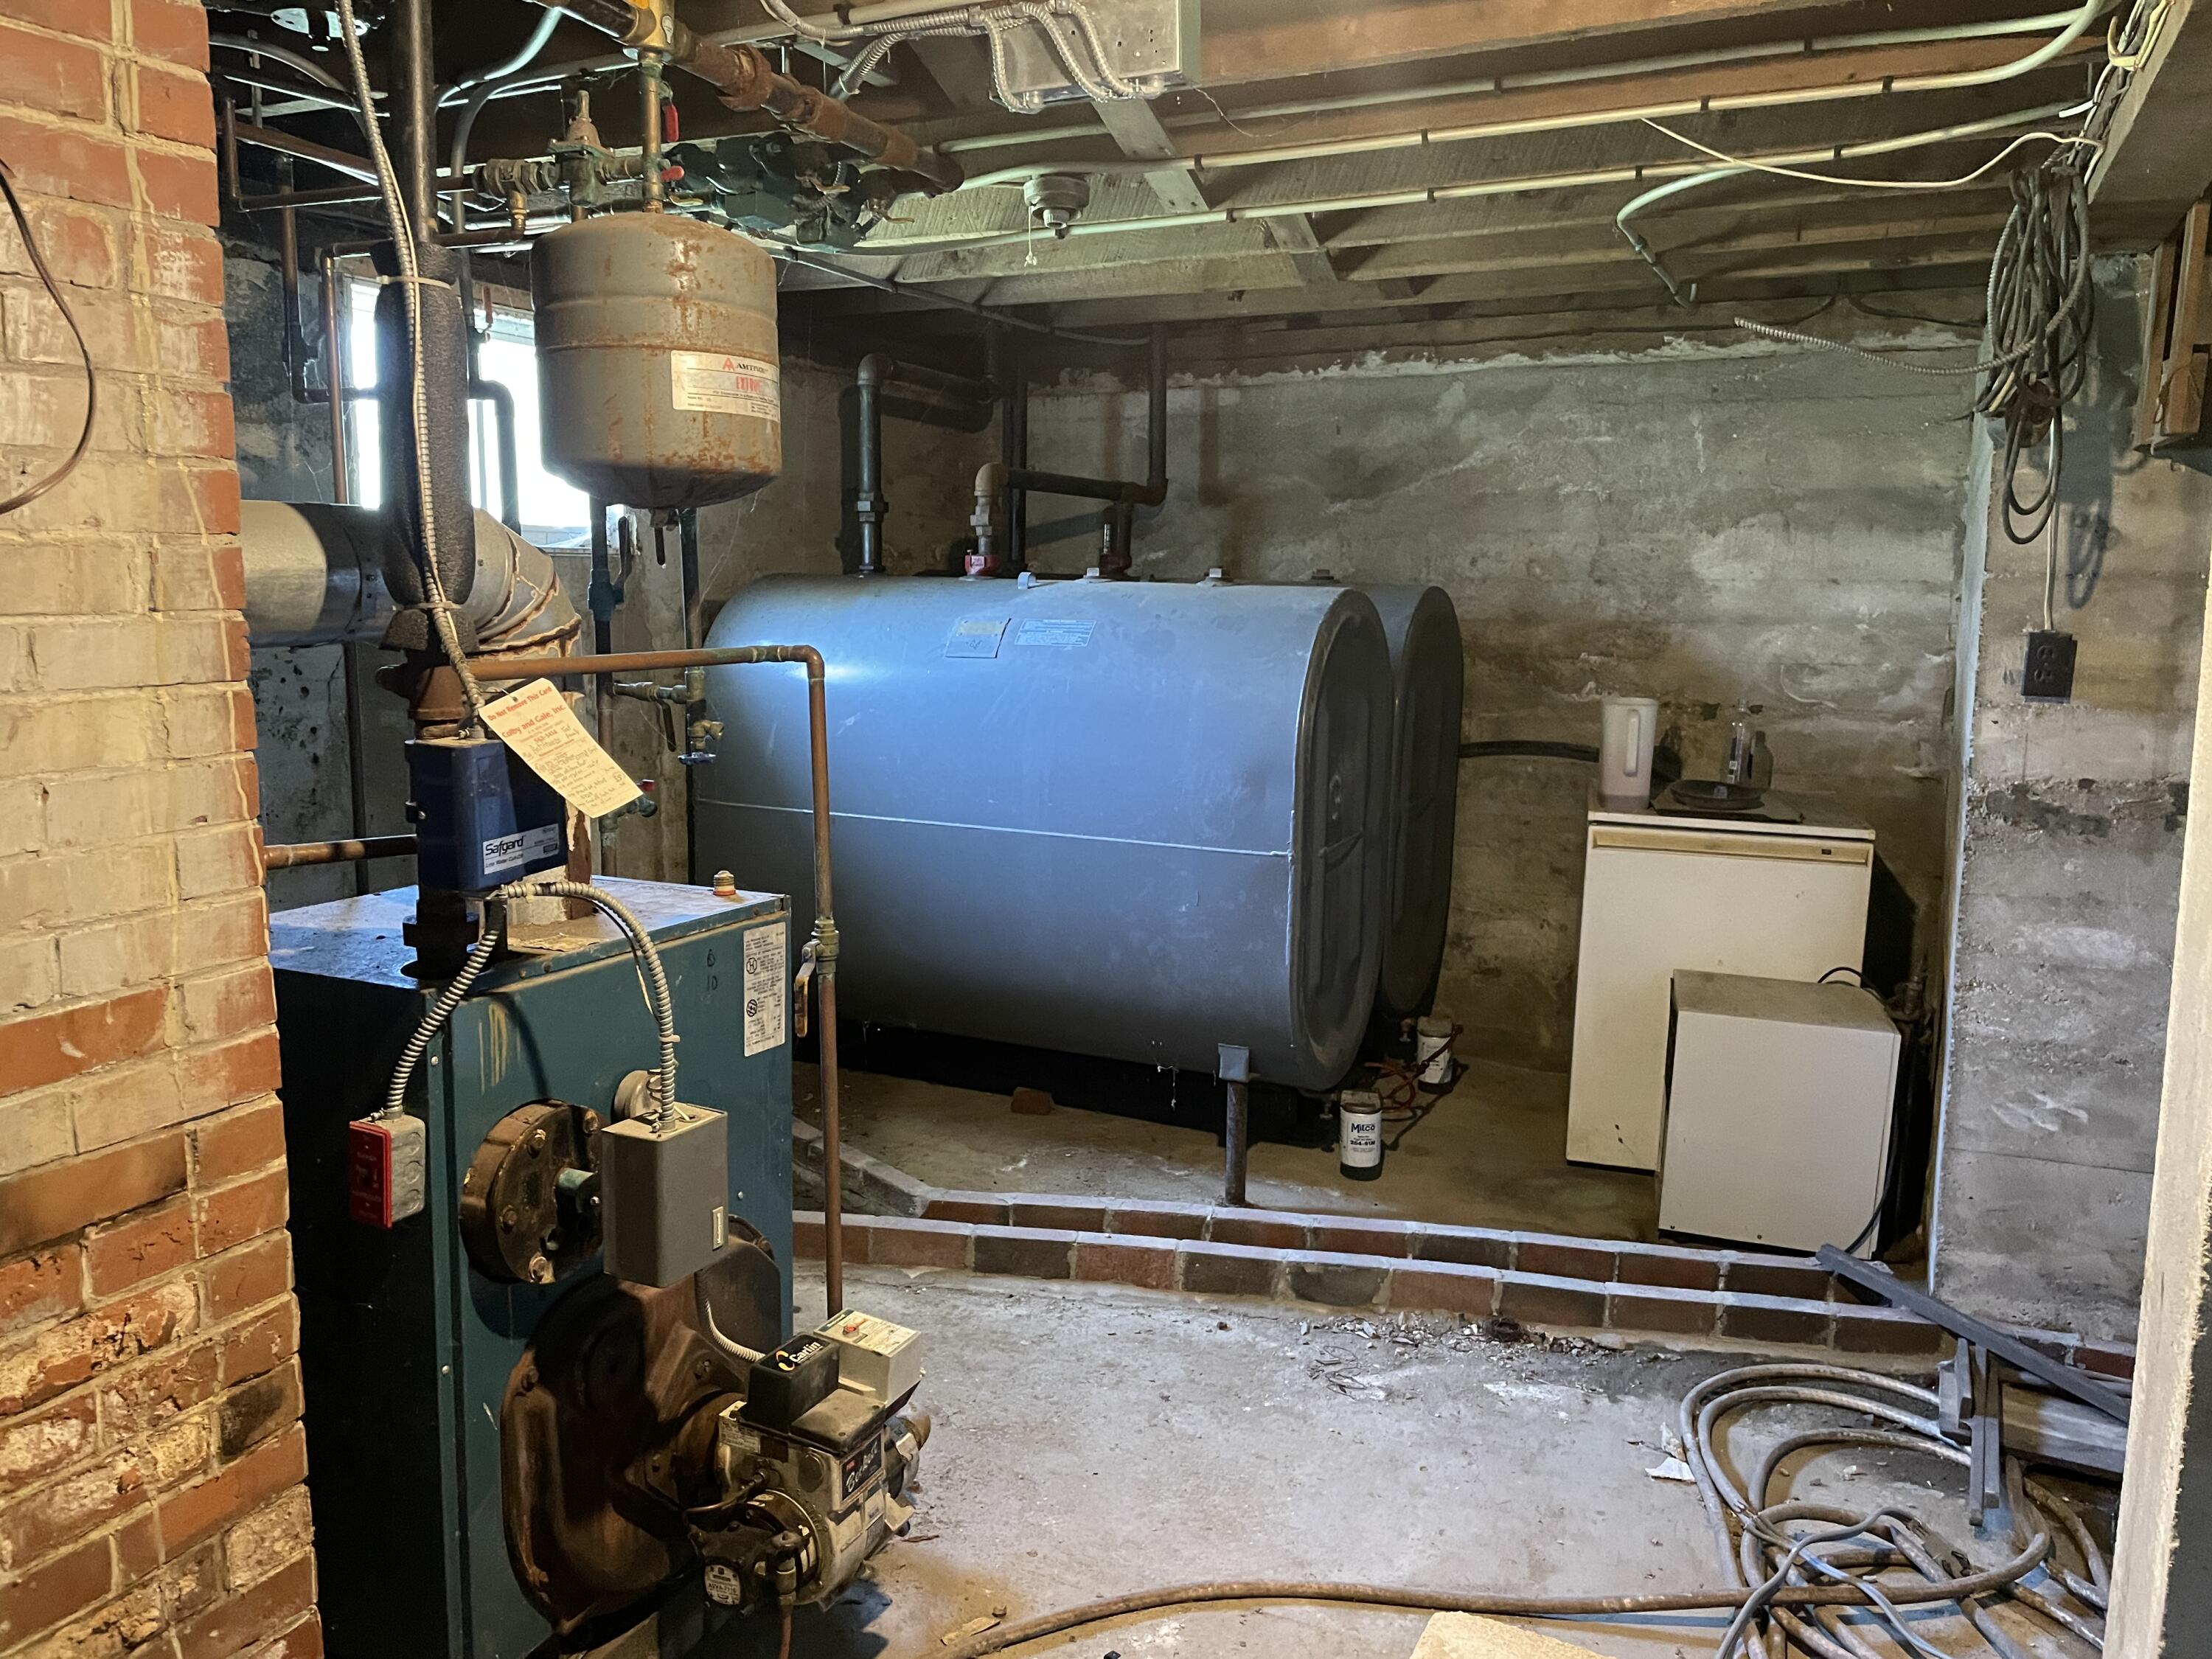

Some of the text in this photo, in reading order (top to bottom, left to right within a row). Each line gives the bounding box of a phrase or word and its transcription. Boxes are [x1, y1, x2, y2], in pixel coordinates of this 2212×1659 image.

[495, 709, 507, 717] Not
[506, 700, 527, 712] Remove
[526, 693, 540, 702] This
[539, 686, 552, 696] Card
[501, 727, 522, 738] Colby
[521, 720, 535, 730] and
[552, 705, 566, 714] Inc.
[485, 835, 524, 857] Safgard
[789, 1341, 821, 1363] Carlin
